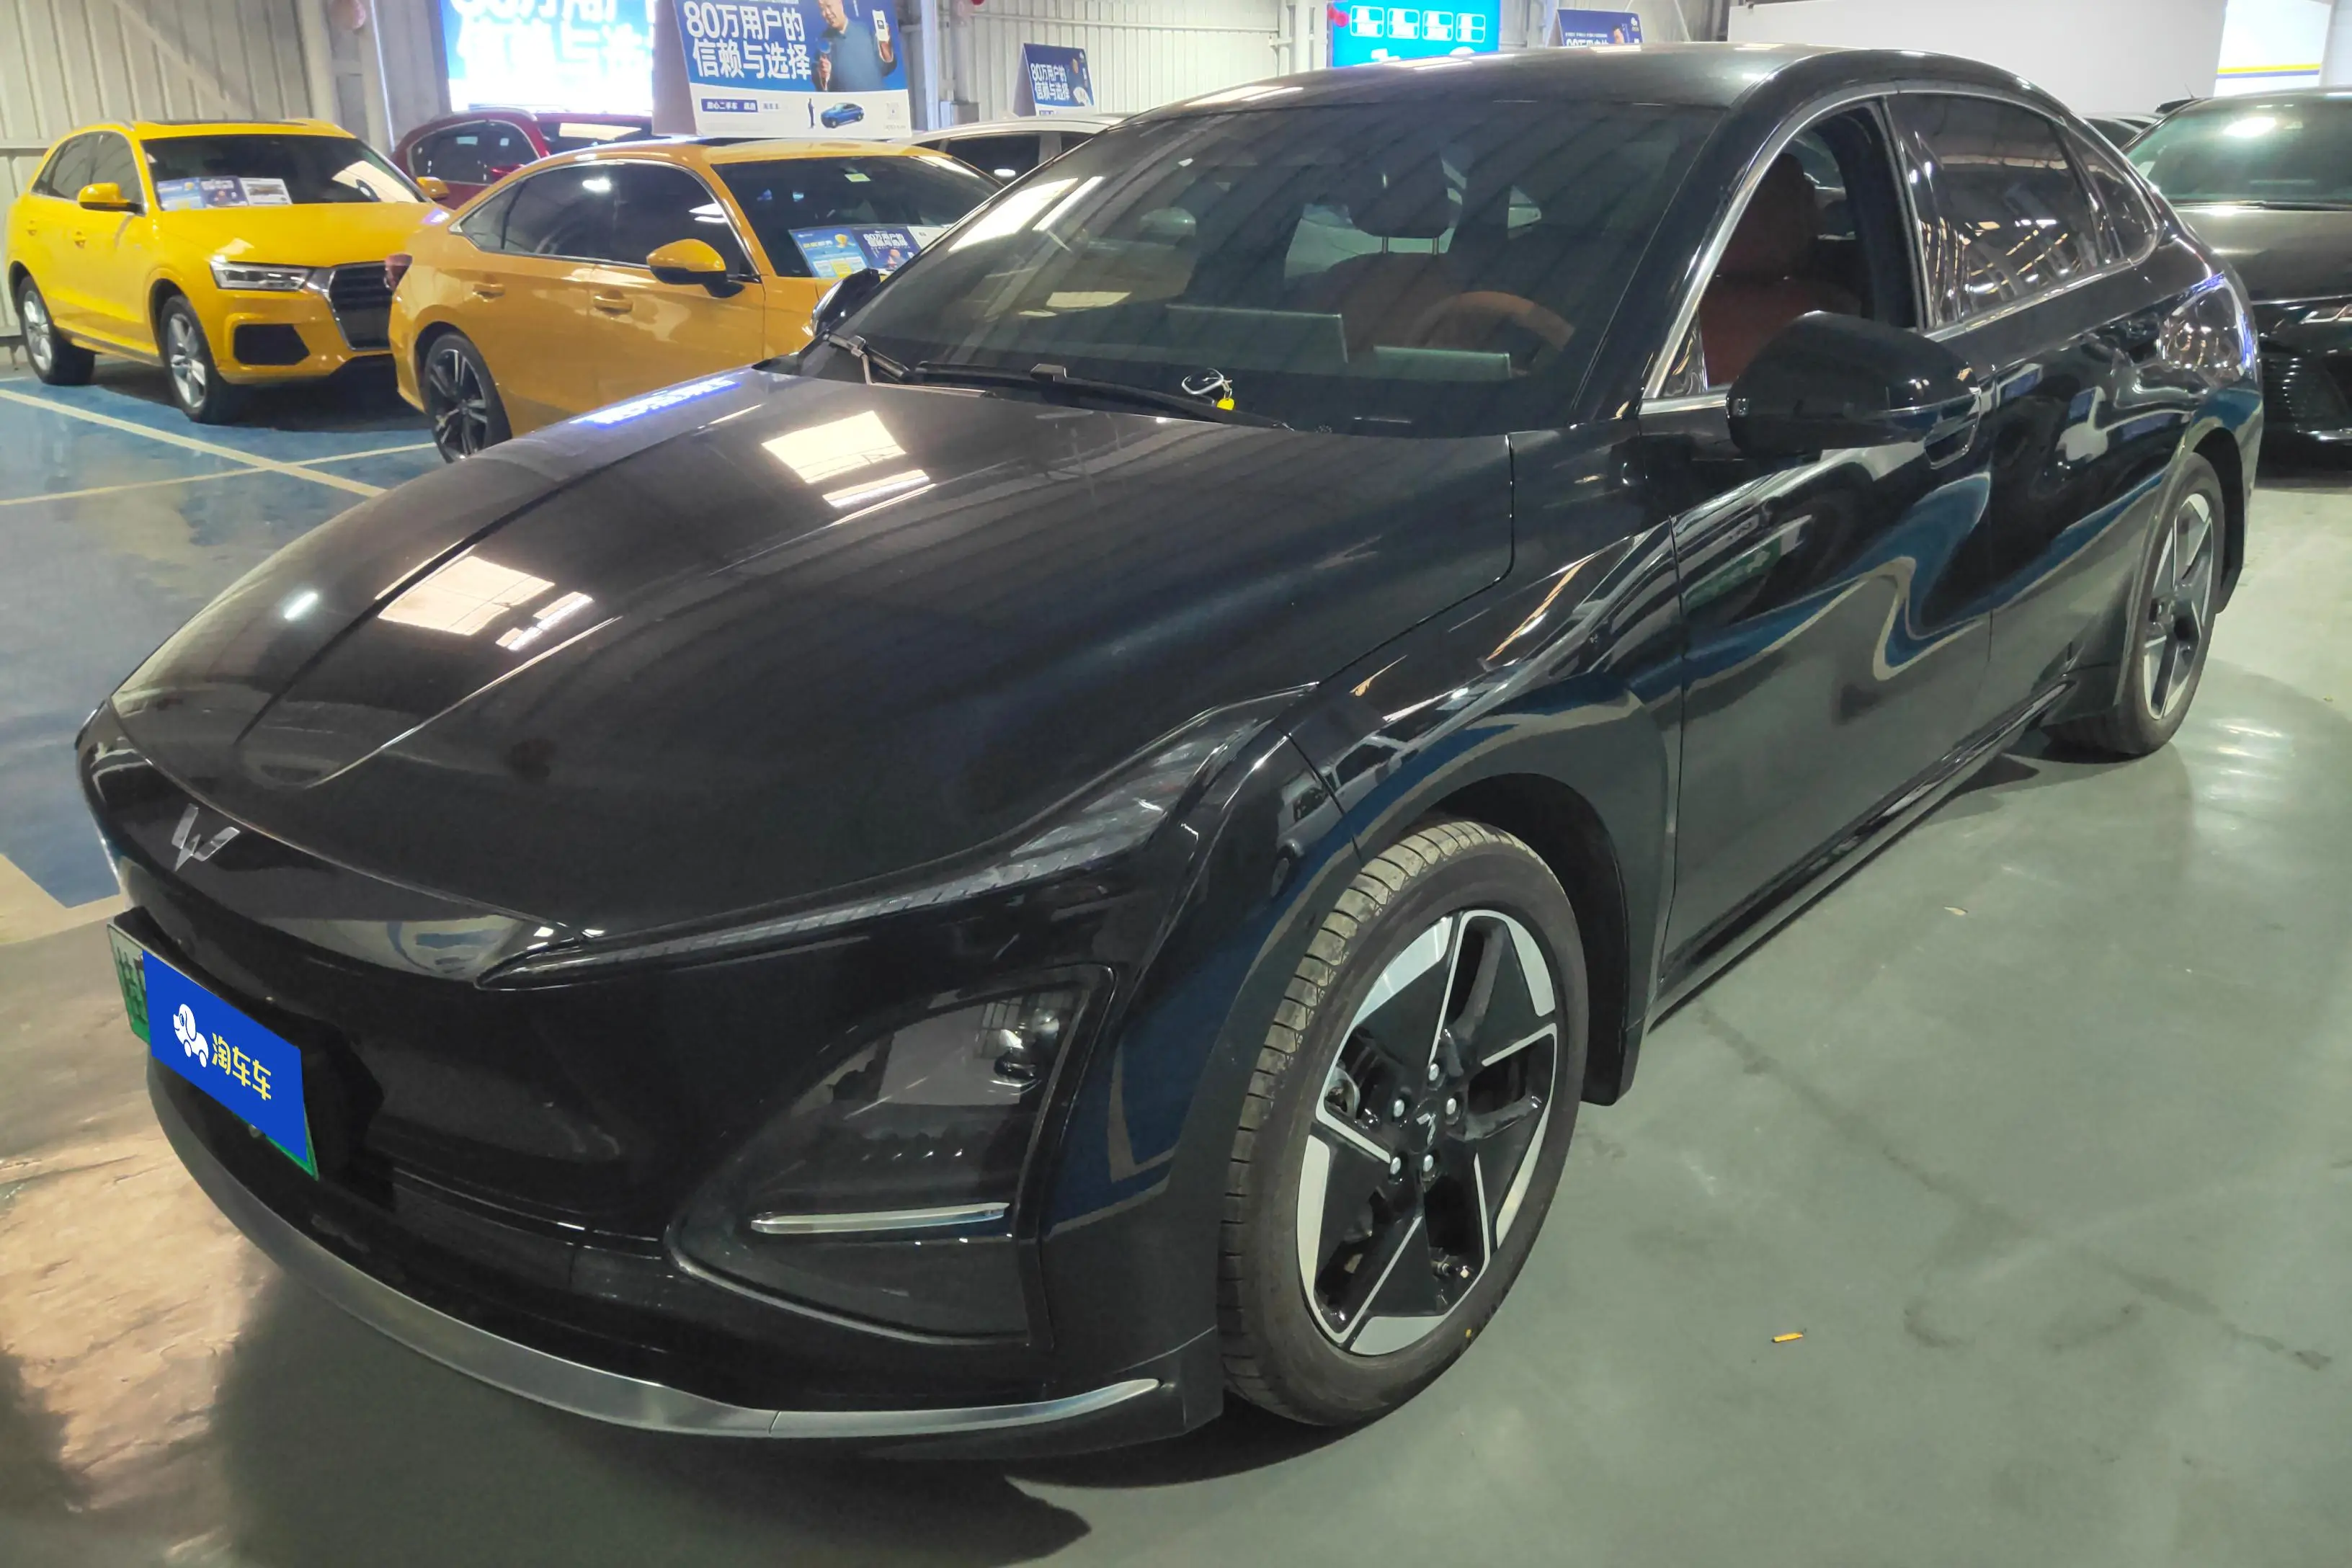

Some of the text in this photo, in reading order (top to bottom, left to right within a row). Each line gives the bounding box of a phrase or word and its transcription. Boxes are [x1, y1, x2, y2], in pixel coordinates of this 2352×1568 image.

[684, 3, 805, 42] 80万用户的
[692, 38, 812, 81] 信赖与选择
